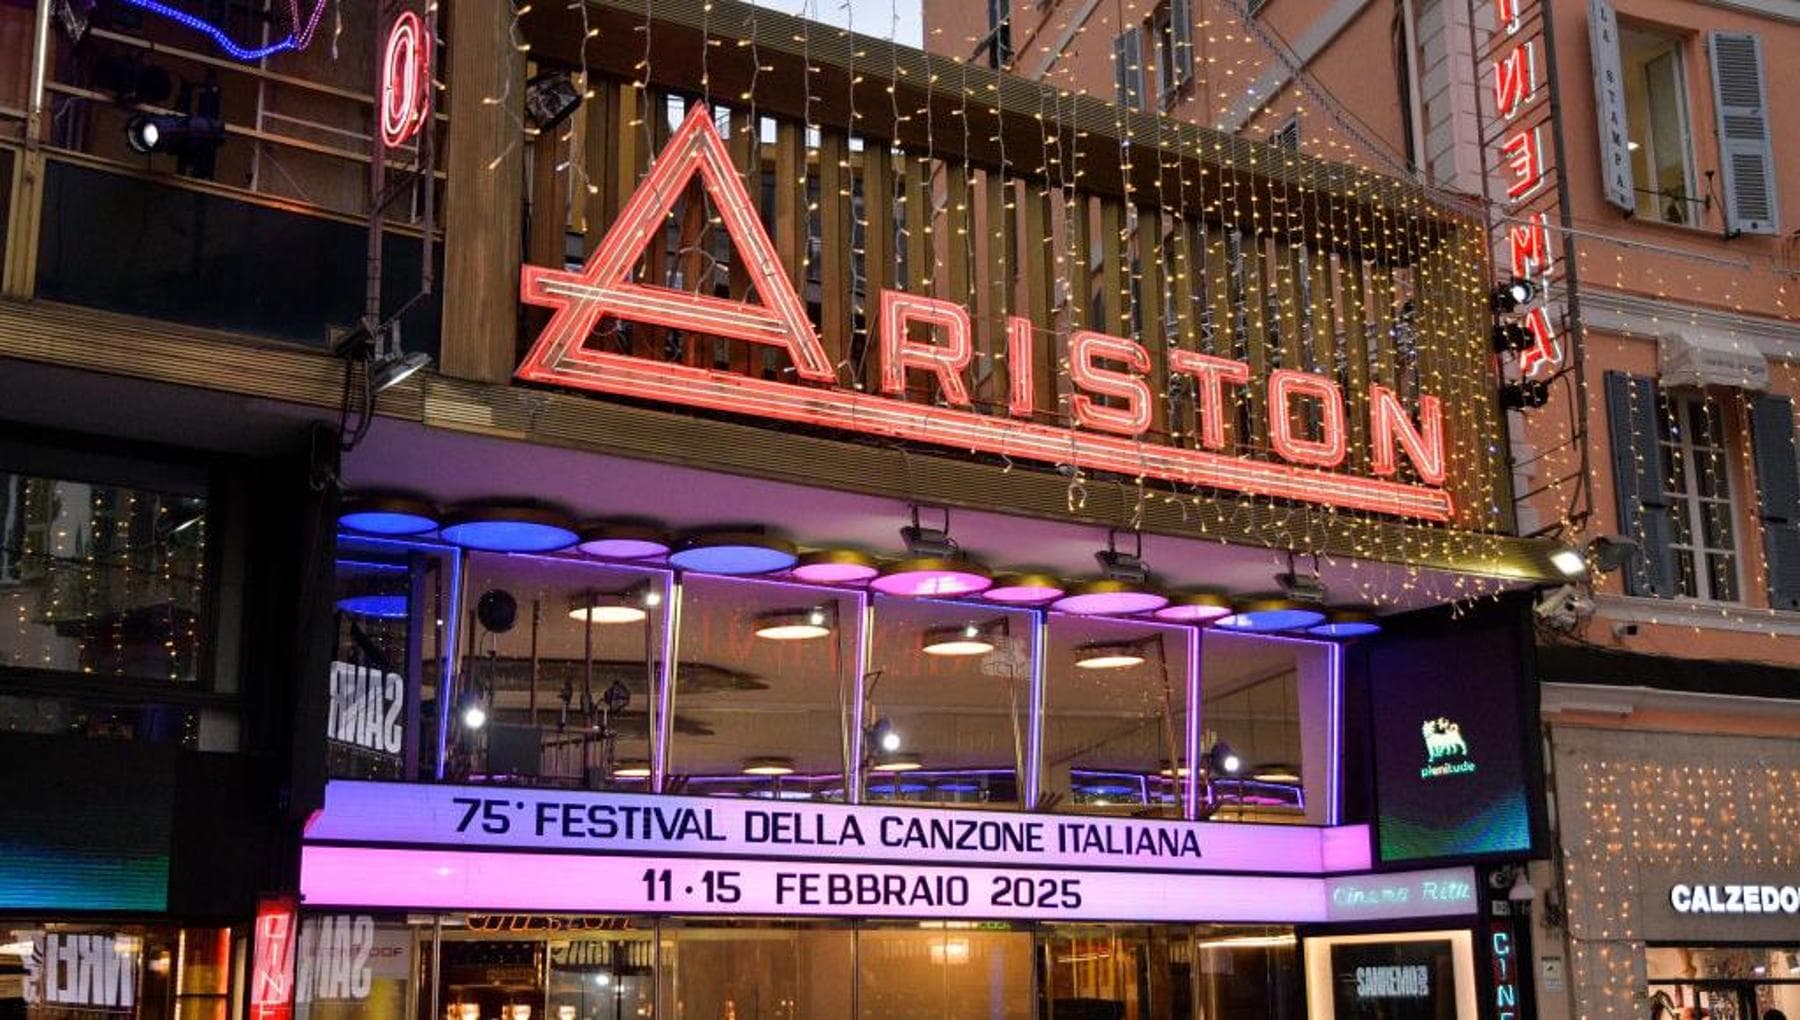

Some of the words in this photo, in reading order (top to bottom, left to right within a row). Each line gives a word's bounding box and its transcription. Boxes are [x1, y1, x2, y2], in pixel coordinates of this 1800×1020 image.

[514, 98, 1447, 486] ARISTON
[1421, 760, 1477, 779] plenitude
[535, 801, 727, 841] FESTIVAL
[745, 811, 865, 845] DELLA
[880, 816, 1045, 853] CANZONE
[1058, 824, 1202, 858] ITALIANA
[776, 872, 969, 907] FEBBRAIO
[990, 876, 1083, 909] 2025
[1671, 884, 1800, 913] CALZEDO
